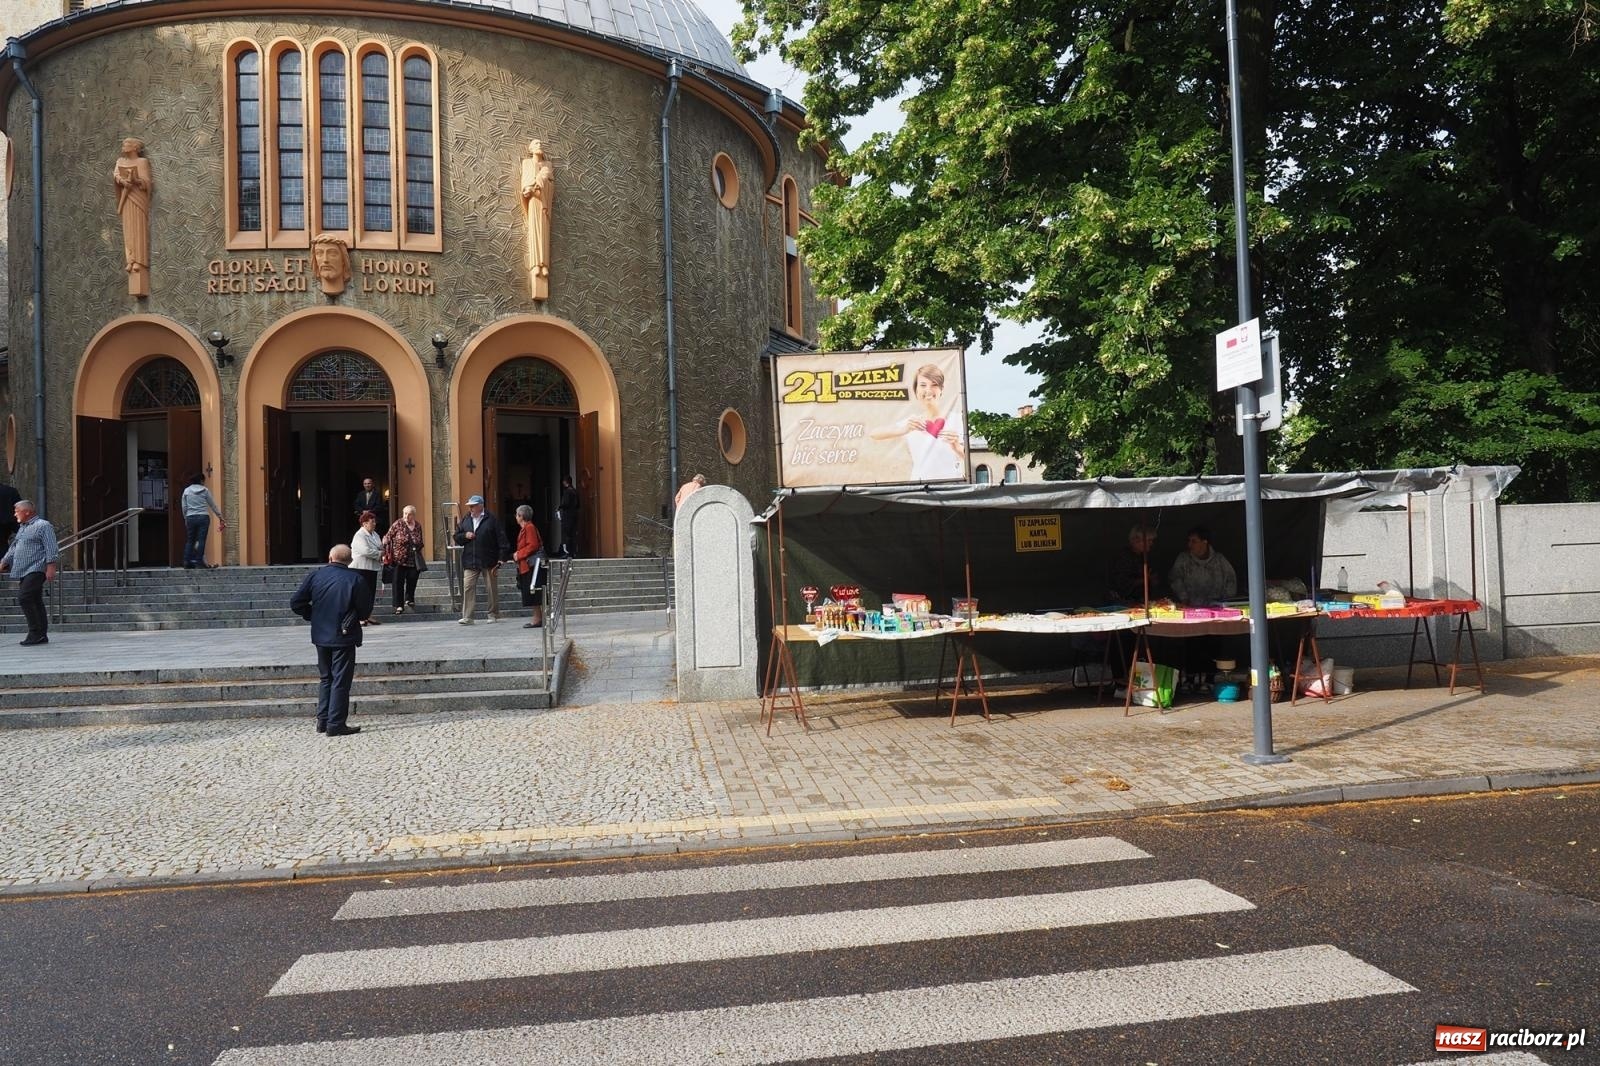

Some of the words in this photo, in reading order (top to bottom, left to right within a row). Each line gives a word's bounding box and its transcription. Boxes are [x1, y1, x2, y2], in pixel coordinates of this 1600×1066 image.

[208, 258, 276, 275] GLORIA
[284, 257, 307, 273] ET
[361, 258, 429, 276] HONOR
[207, 278, 248, 294] REGI
[783, 371, 838, 404] 21
[838, 363, 900, 386] DZIEŃ
[838, 391, 852, 399] OD
[854, 390, 906, 400] POCZĘCIA
[799, 419, 864, 448] Zaczyna
[790, 445, 816, 465] bić
[818, 450, 857, 464] serce
